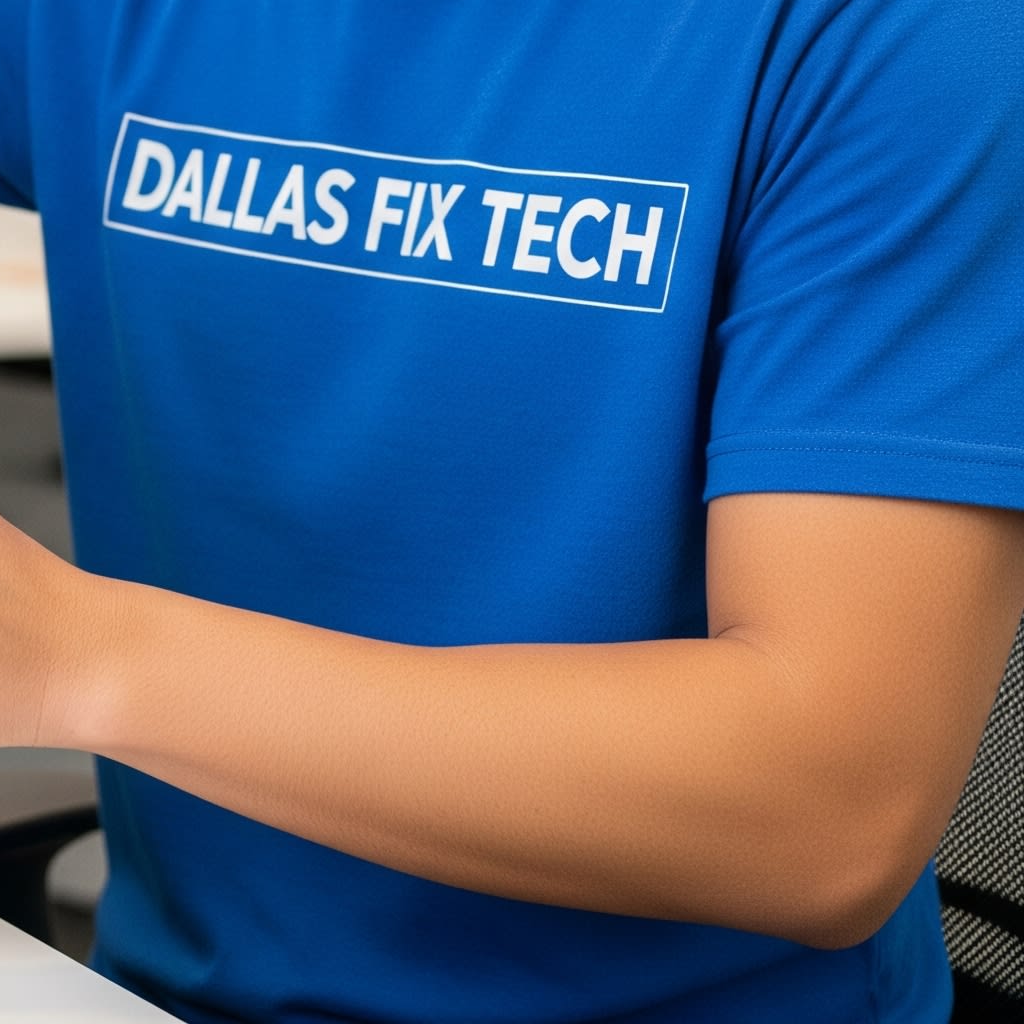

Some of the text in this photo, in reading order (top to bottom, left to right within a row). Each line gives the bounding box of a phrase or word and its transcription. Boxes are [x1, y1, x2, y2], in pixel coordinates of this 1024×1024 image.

[122, 139, 664, 285] DALLAS FIX TECH
